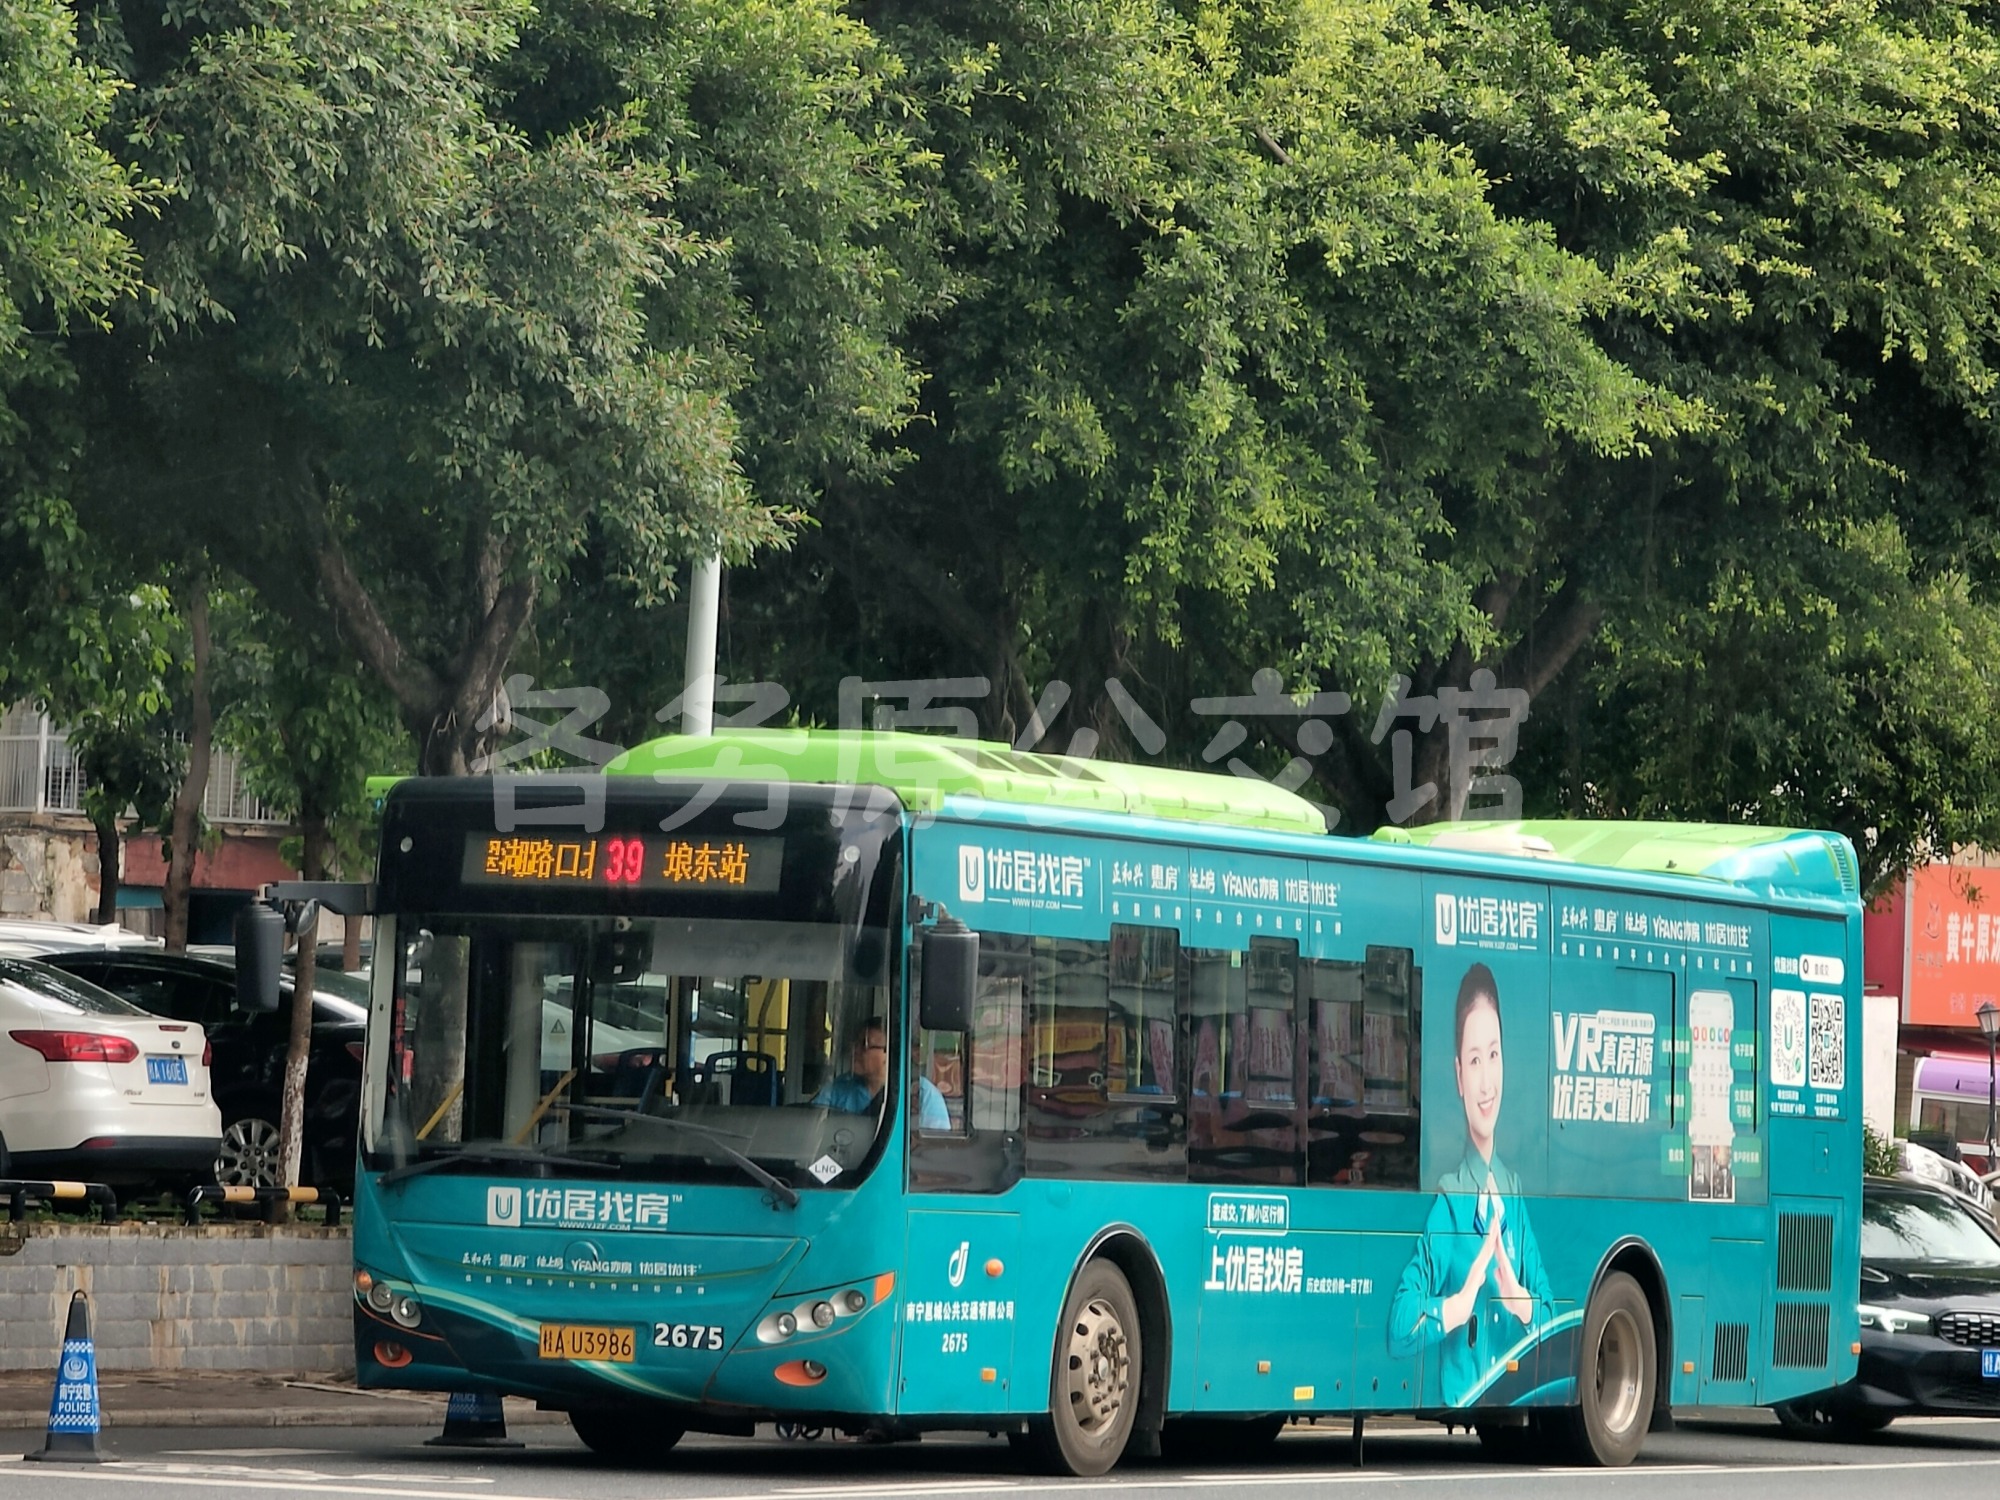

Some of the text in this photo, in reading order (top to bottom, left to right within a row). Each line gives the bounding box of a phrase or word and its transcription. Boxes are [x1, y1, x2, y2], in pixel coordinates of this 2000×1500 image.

[604, 839, 645, 882] 39
[663, 841, 751, 884] 埌东站
[987, 847, 1084, 898] 优居找房
[1459, 896, 1537, 939] 优居找房
[1552, 1075, 1651, 1123] 优居更懂你
[814, 1164, 837, 1174] LNG
[526, 1187, 669, 1224] 优居找房
[1205, 1245, 1303, 1293] 上优居找房
[654, 1322, 724, 1350] 2675
[941, 1333, 968, 1353] 2675
[58, 1402, 91, 1413] POLICE
